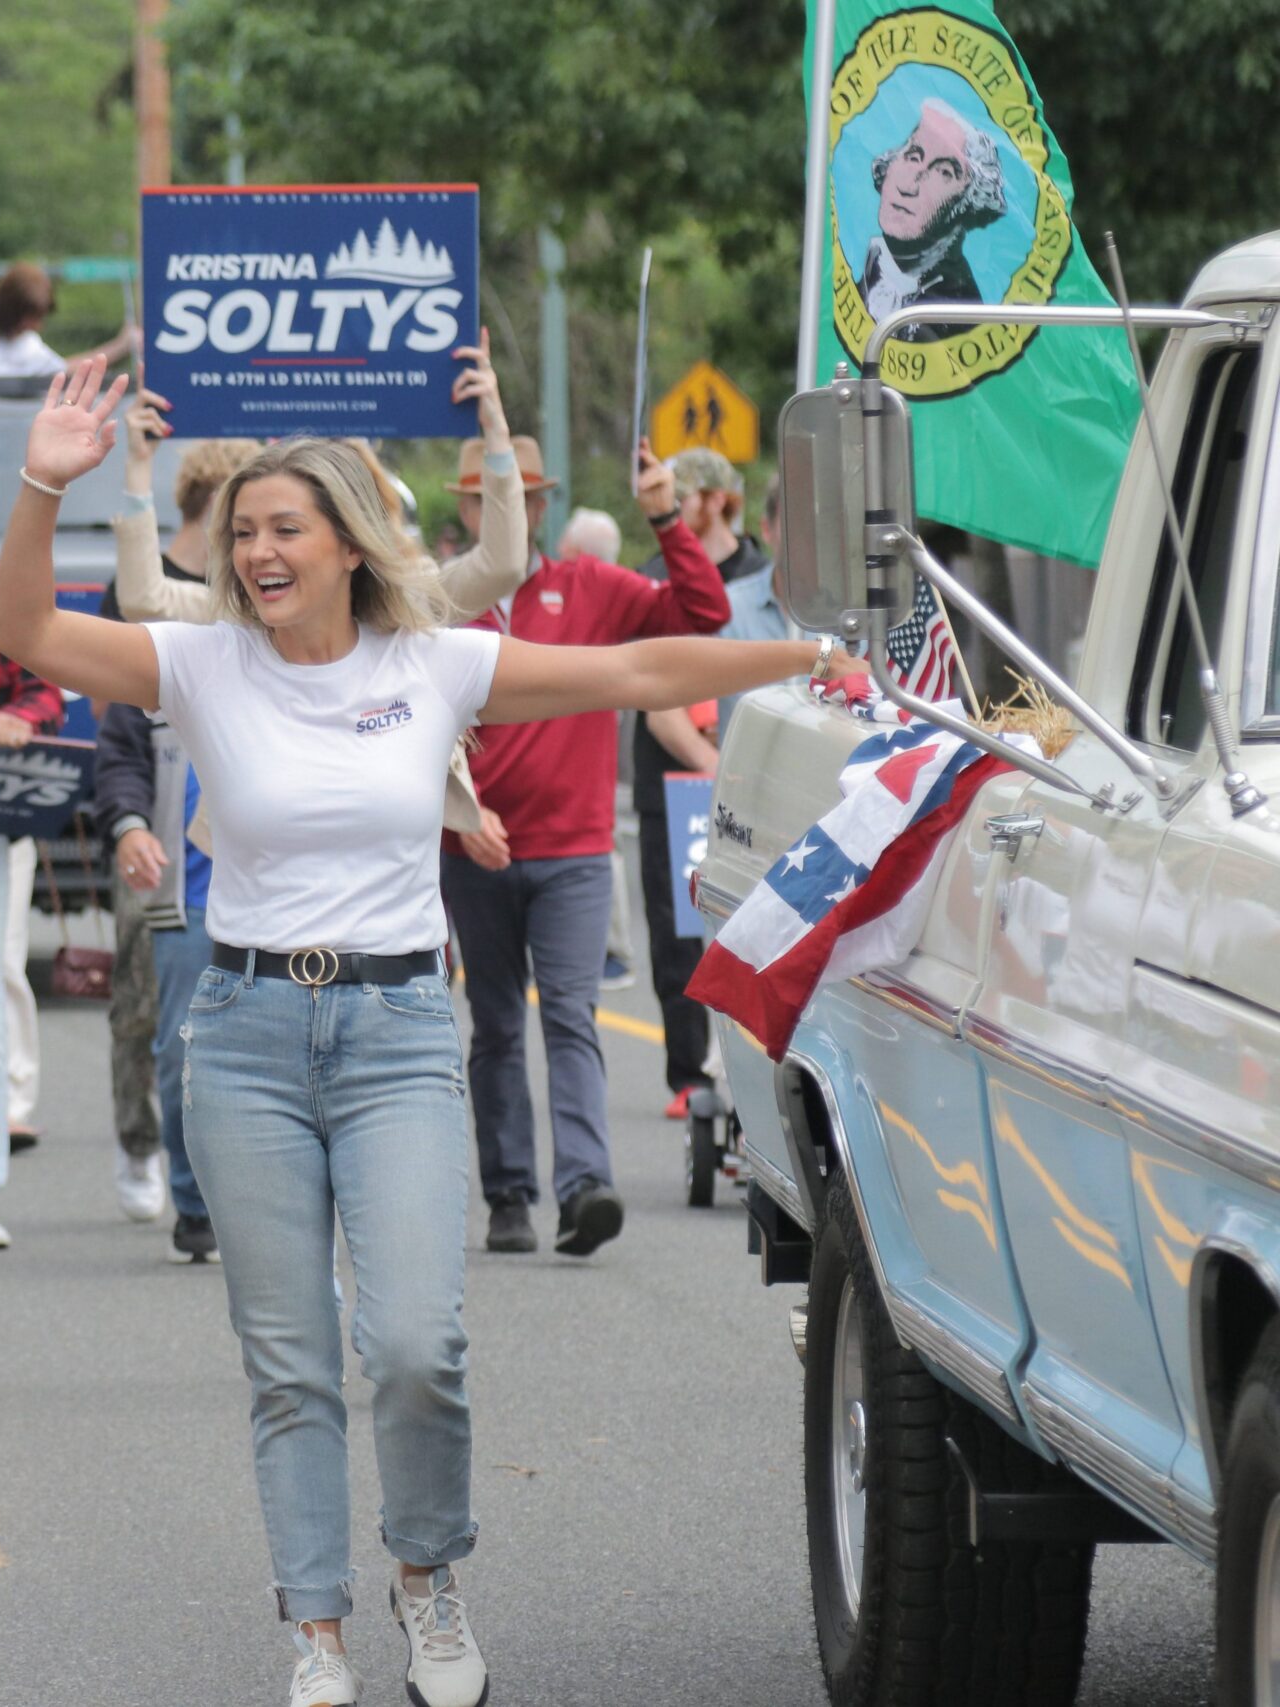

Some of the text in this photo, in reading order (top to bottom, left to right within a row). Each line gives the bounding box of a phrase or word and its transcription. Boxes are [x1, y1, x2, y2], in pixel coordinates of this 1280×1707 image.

[830, 68, 863, 116] OF
[866, 25, 919, 71] THE
[932, 24, 1012, 98] STATE
[1002, 105, 1034, 145] OF
[166, 254, 318, 281] KRISTINA
[154, 287, 464, 354] SOLTYS
[190, 370, 428, 387] FOR 47TH LD STATE SENATE (R)
[241, 401, 378, 412] KRISTINAFORSENATE.COM
[356, 707, 413, 733] SOLTYS
